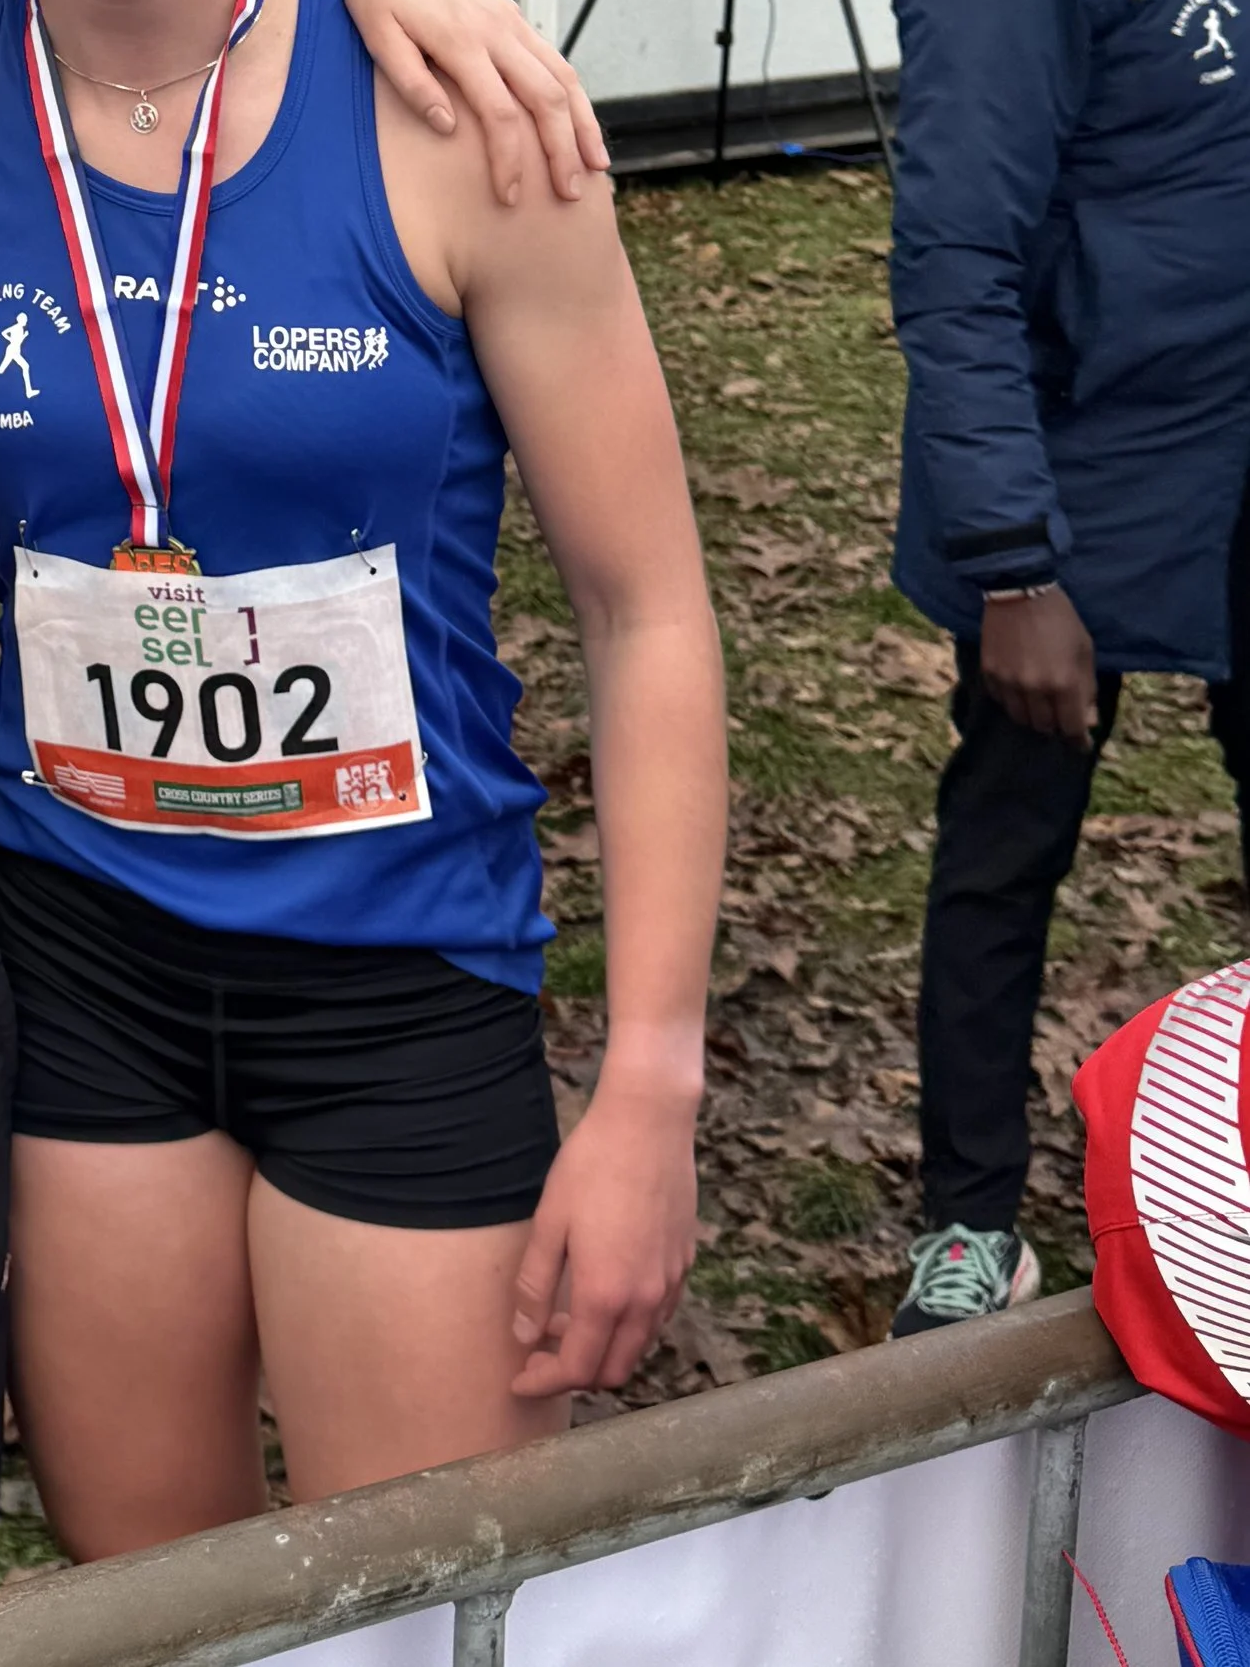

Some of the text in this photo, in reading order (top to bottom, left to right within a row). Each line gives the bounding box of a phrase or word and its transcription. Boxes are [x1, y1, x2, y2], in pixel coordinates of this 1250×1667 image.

[31, 288, 72, 335] TEAM
[252, 325, 361, 351] LOPERS
[253, 348, 364, 372] COMPANY
[148, 582, 206, 604] visit
[134, 604, 207, 634] eer
[86, 662, 339, 763] 1902
[158, 786, 190, 801] CROSS
[191, 790, 241, 805] COUNTRY
[244, 788, 282, 804] SERIES
